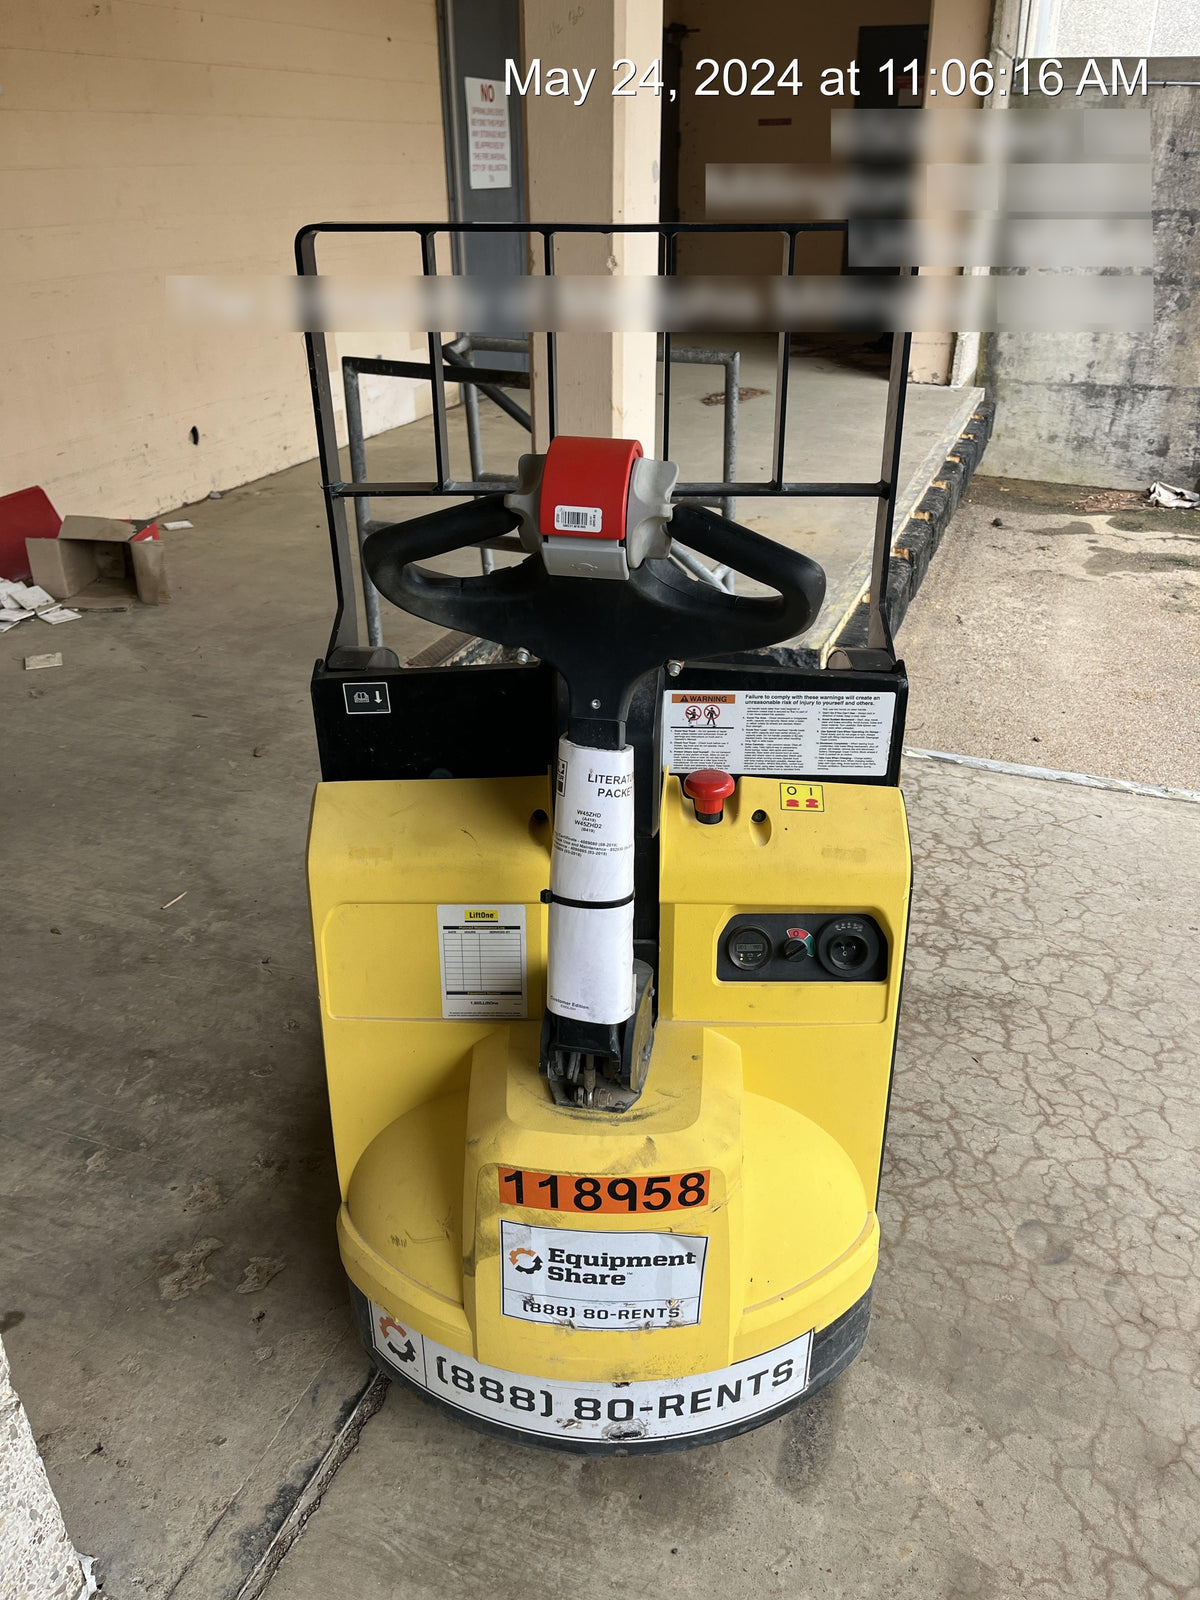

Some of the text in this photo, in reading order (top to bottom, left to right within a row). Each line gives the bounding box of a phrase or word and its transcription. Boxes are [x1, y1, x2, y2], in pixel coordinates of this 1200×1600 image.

[480, 84, 495, 103] NO
[690, 695, 728, 703] WARNING
[577, 809, 602, 818] W45ZHD
[574, 819, 602, 829] W45ZHD2
[469, 911, 494, 919] LiftOne
[504, 1170, 705, 1212] 118958
[548, 1247, 697, 1272] Equipment
[547, 1265, 627, 1286] Share
[522, 1300, 680, 1320] (888) 80-RENTS
[436, 1355, 795, 1422] (888) 80-RENTS
